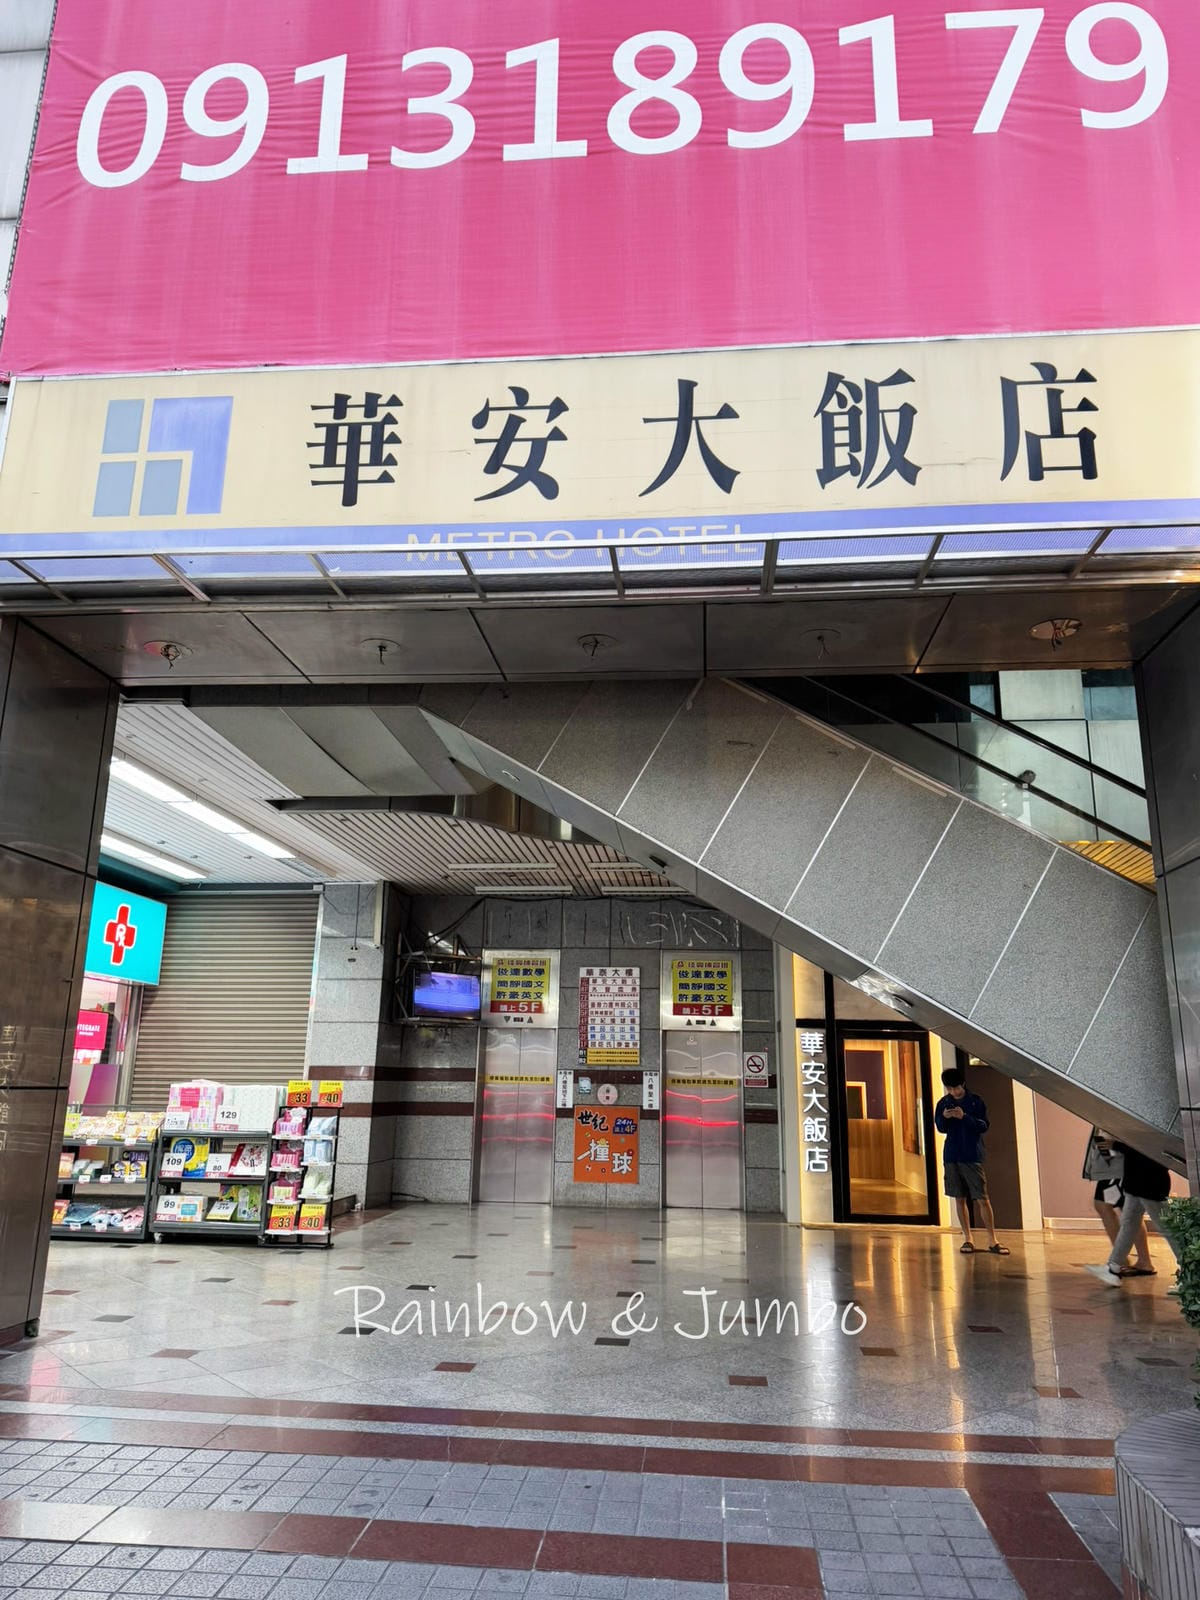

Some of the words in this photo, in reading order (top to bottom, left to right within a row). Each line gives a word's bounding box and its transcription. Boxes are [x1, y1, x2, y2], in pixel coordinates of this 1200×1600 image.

[76, 1, 1169, 188] 0913189179
[307, 361, 1099, 506] 華安大飯店
[404, 528, 576, 564] METRO
[595, 523, 758, 561] HOTEL
[220, 1111, 237, 1119] 129
[800, 1032, 829, 1172] 華安大飯店
